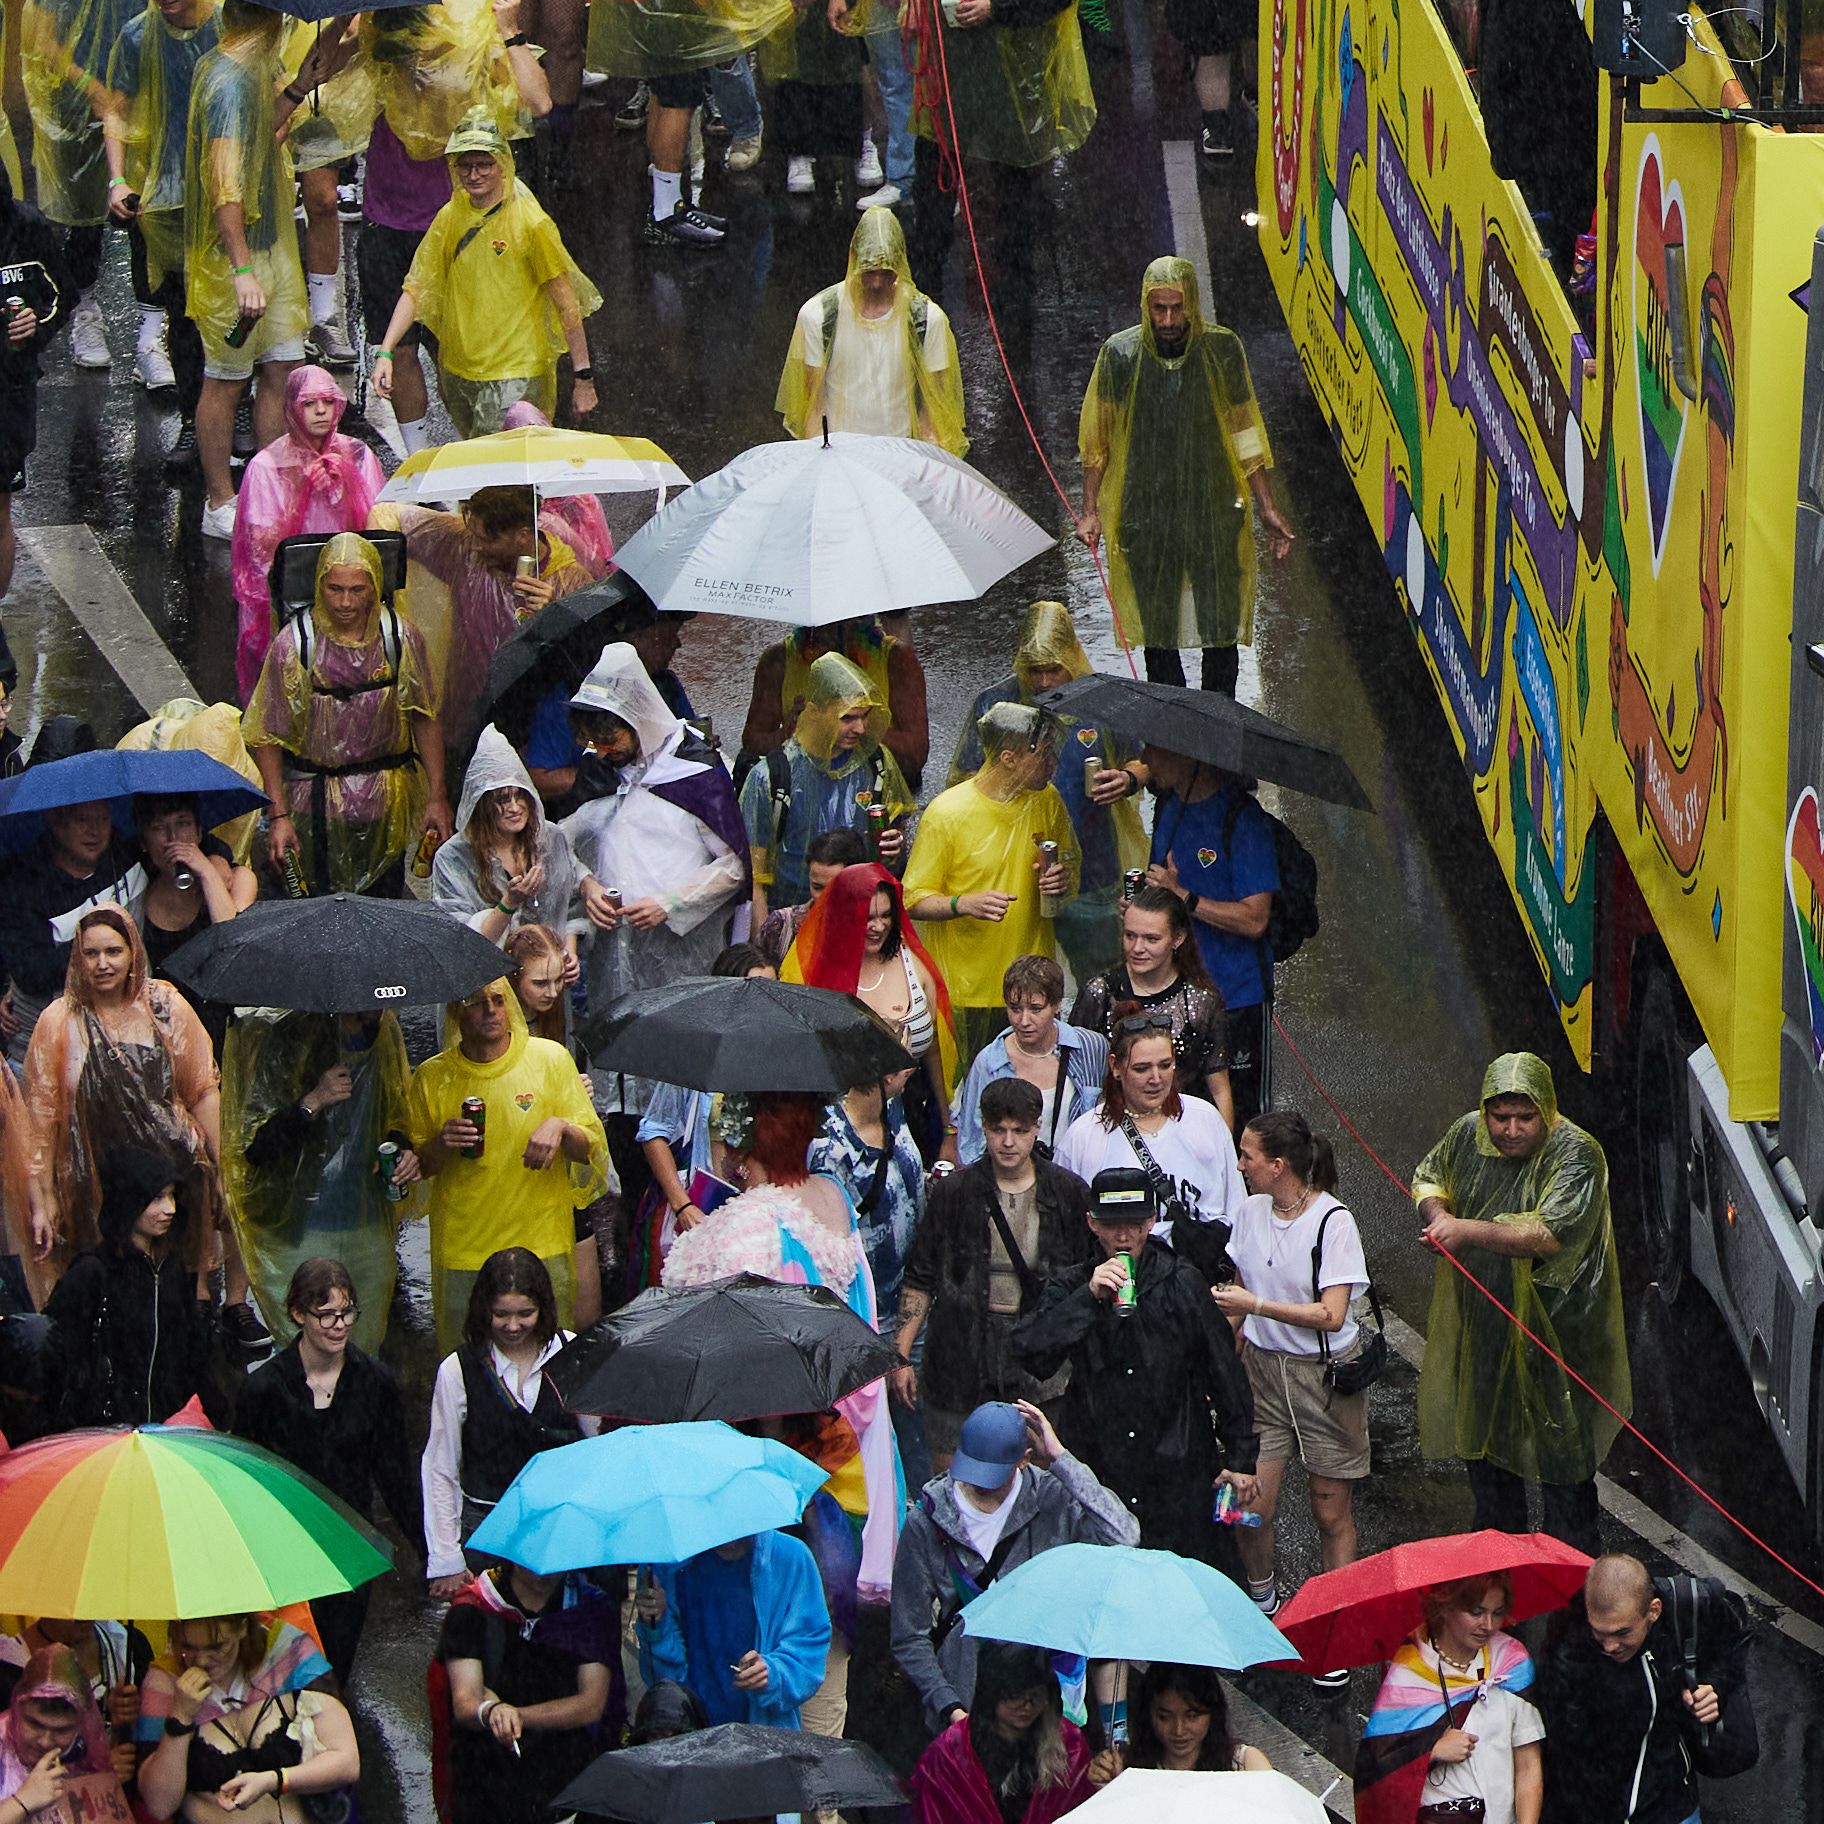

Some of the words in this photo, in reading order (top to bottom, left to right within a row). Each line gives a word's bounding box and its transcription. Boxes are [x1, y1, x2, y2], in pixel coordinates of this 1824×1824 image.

[3, 269, 24, 285] BVG
[694, 577, 741, 593] ELLEN
[744, 582, 795, 598] BETRIX
[1685, 783, 1702, 843] Str.
